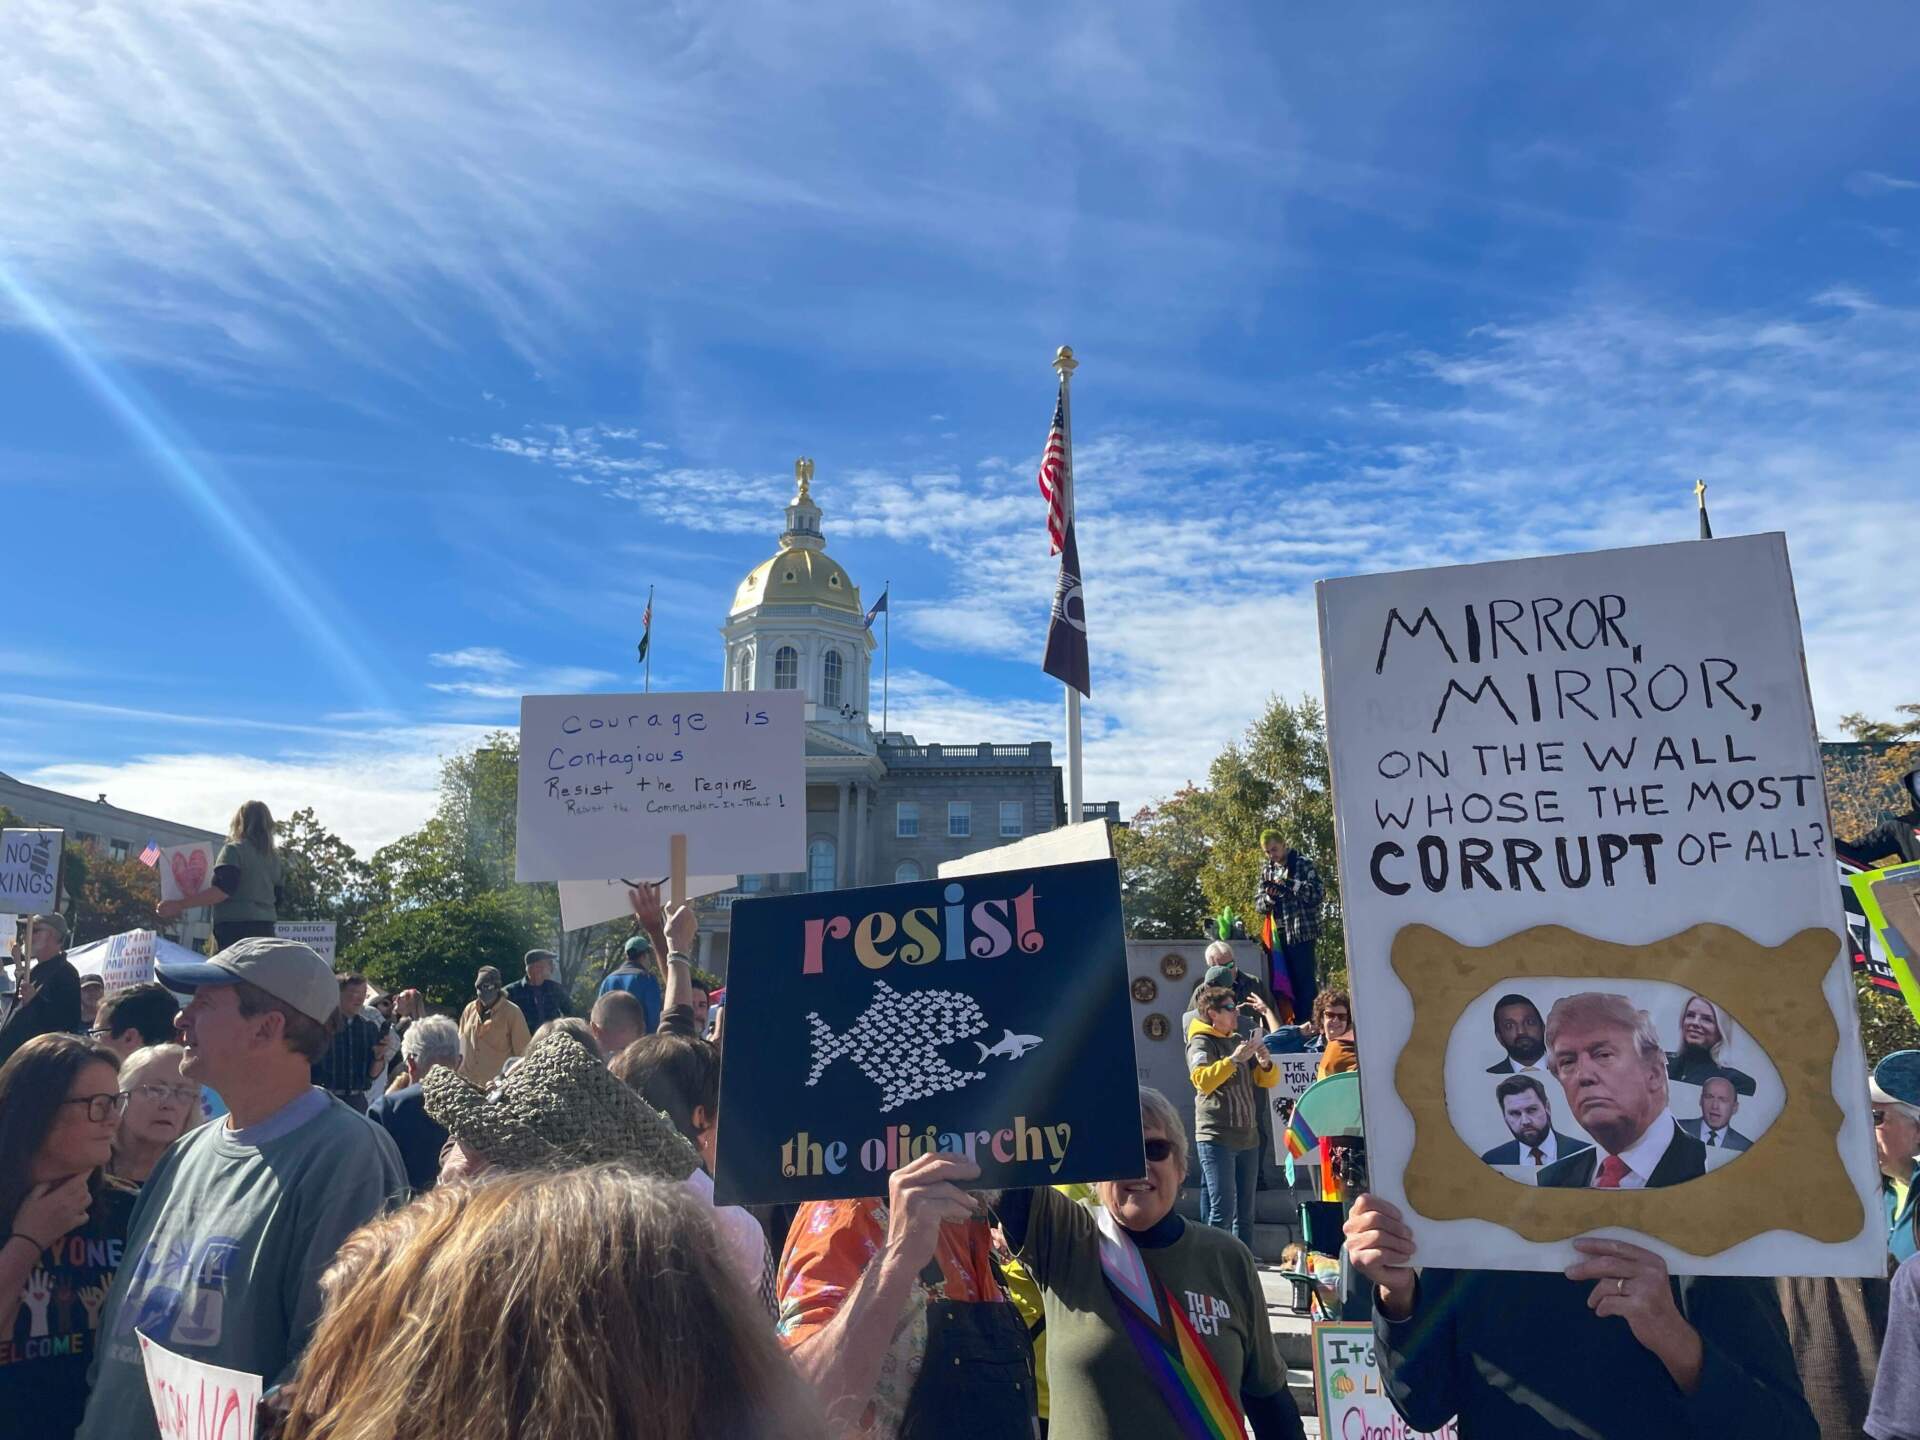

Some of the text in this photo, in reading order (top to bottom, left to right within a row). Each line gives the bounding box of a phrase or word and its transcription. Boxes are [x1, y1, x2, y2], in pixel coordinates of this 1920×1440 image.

[1376, 595, 1642, 674] MIRROR,
[1432, 658, 1762, 733] MIRROR,
[562, 704, 770, 736] Courage is
[548, 746, 684, 774] Contagious
[1378, 735, 1756, 779] ON THE WALL
[544, 777, 757, 798] Resist the regime
[1375, 775, 1815, 830] WHOSE THE MOST
[6, 843, 32, 863] NO
[1370, 822, 1824, 896] CORRUPT OF ALL?
[0, 872, 54, 894] KINGS
[803, 883, 1045, 975] resist
[1282, 1061, 1306, 1072] THE
[781, 1132, 848, 1177] the
[1184, 1290, 1231, 1319] THIRD
